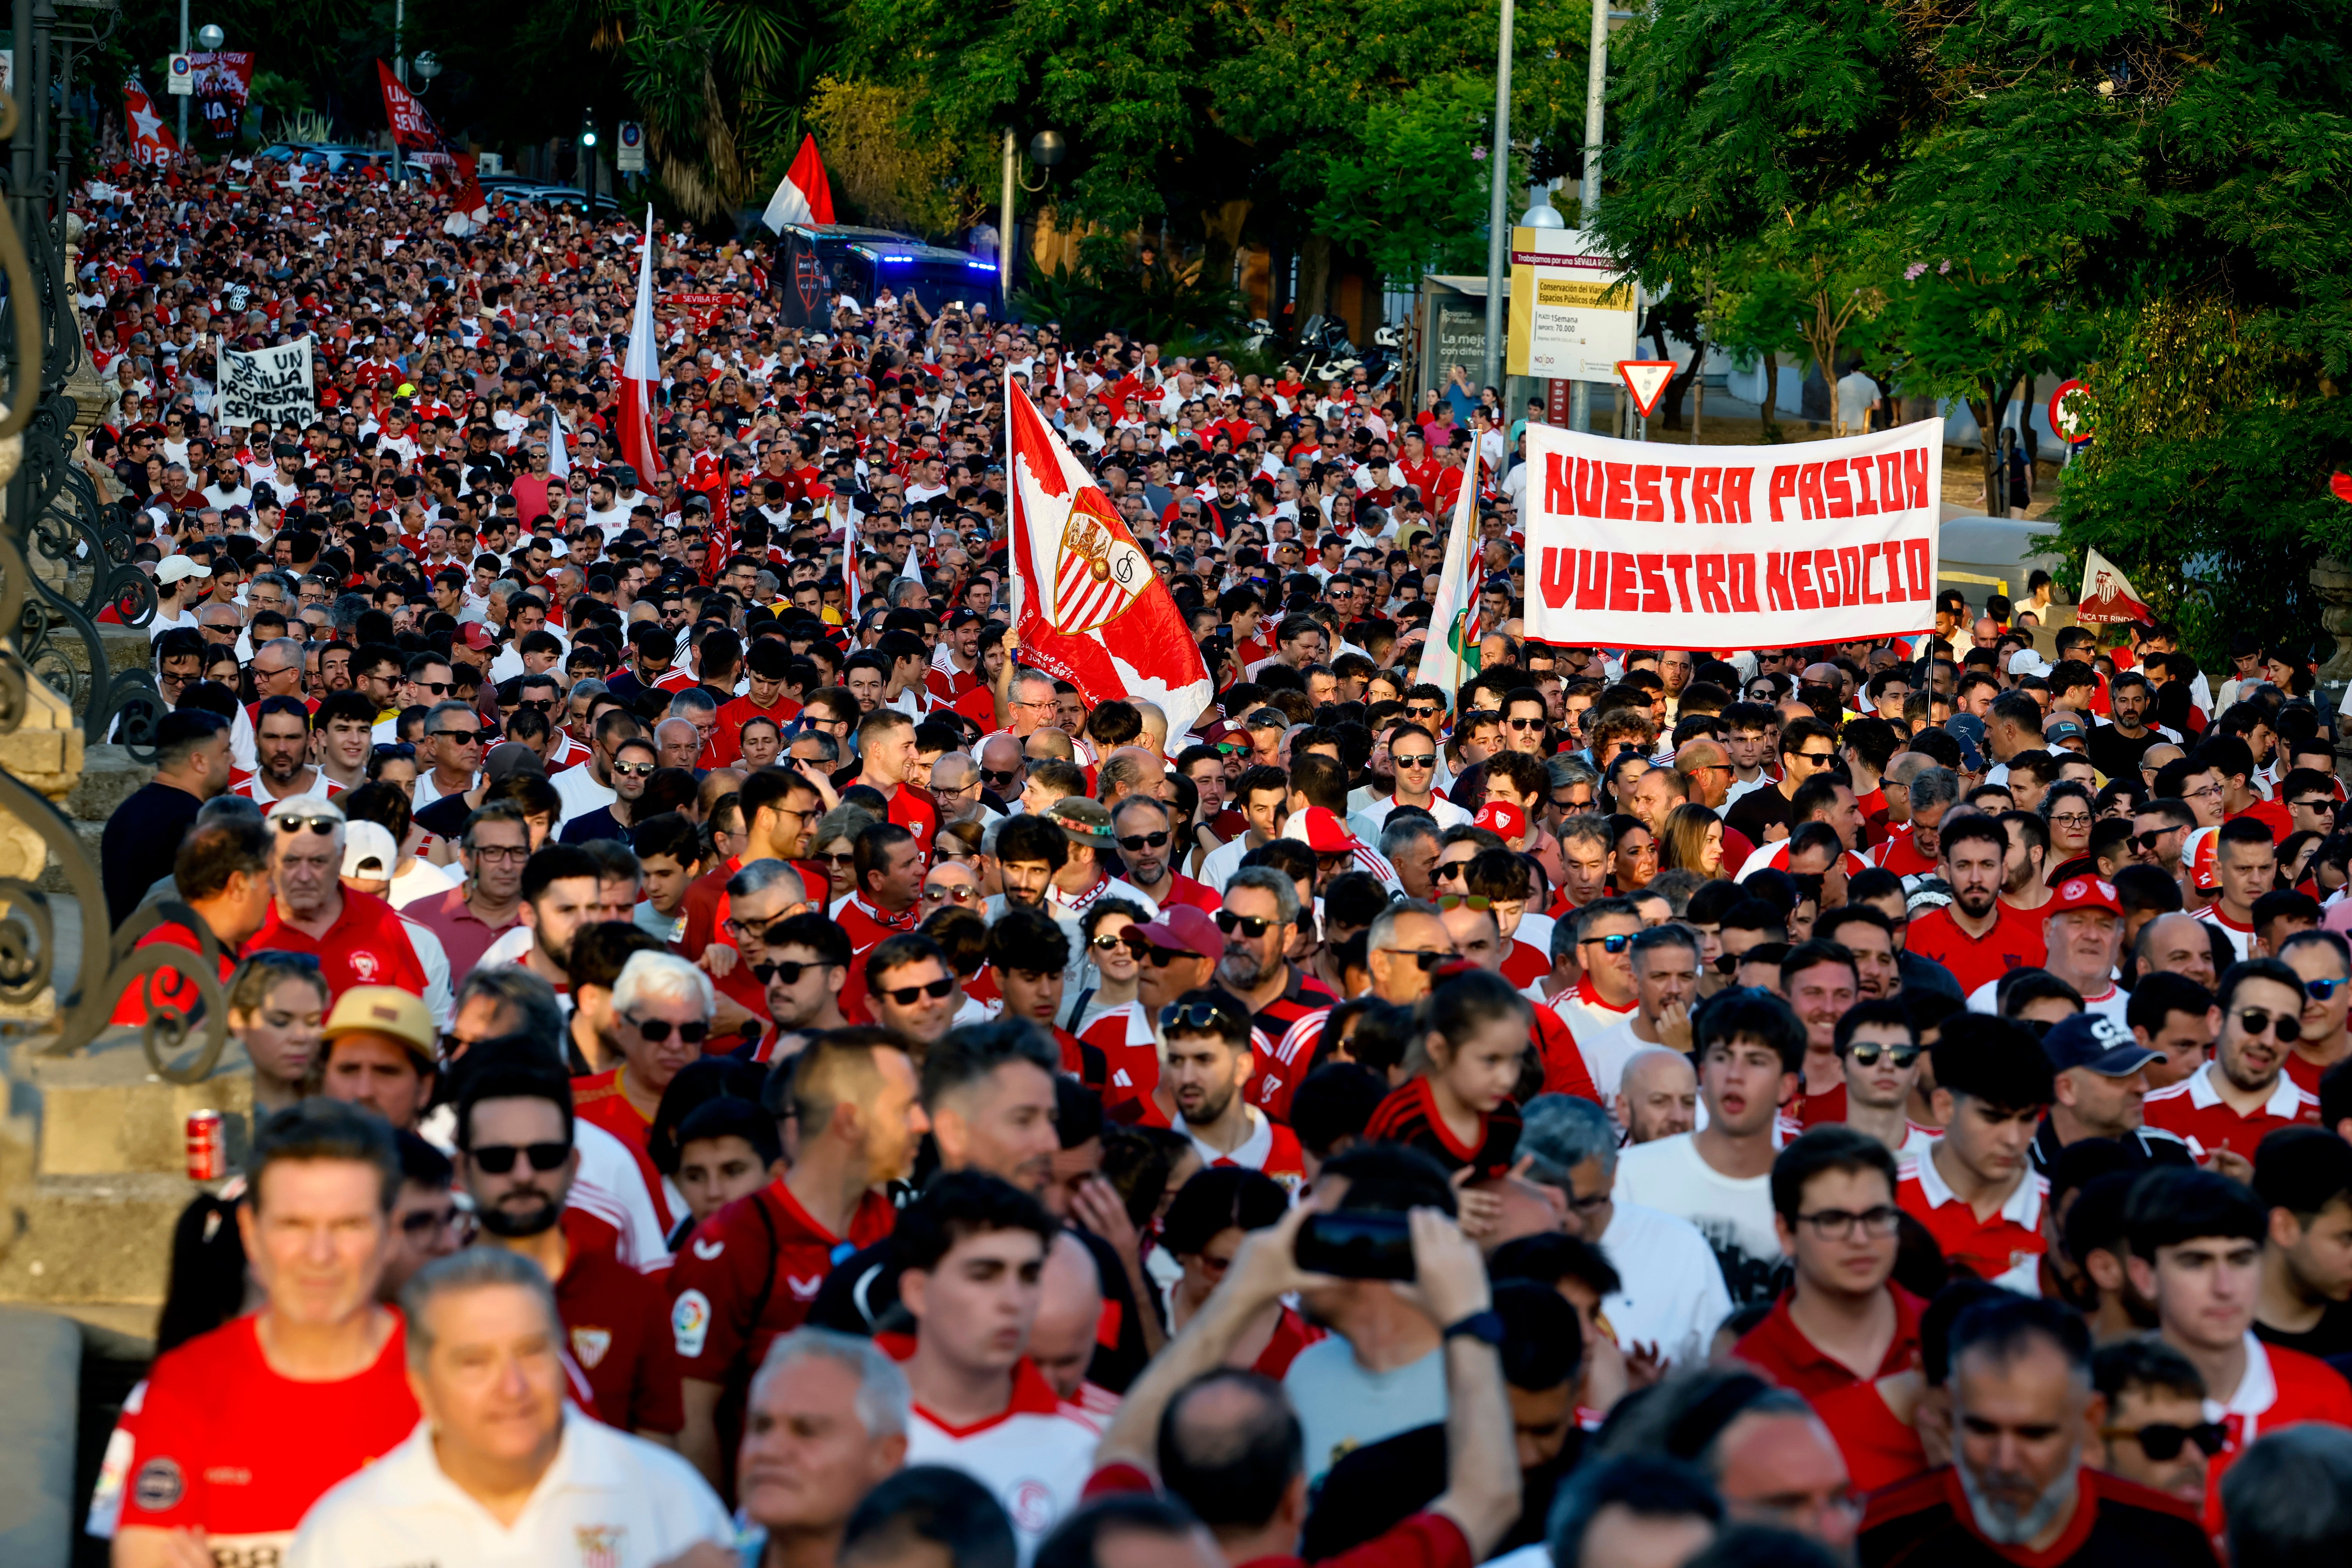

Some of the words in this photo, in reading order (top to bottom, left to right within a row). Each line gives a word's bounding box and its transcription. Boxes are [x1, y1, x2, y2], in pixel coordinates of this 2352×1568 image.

[1518, 254, 1551, 265] Trabajamos
[1551, 257, 1561, 265] por
[1540, 282, 1577, 292] Conservación
[1579, 283, 1588, 293] del
[682, 295, 710, 303] SEVILLA
[1539, 293, 1563, 303] Espacios
[1564, 294, 1588, 304] Públicos
[1555, 324, 1575, 332] 70.000
[1441, 333, 1456, 344] La
[273, 348, 304, 370] UN
[232, 368, 302, 390] SEVILLA
[221, 379, 314, 405] PROFESIONAL
[223, 399, 313, 424] SEVILLISTA
[1545, 452, 1755, 524] NUESTRA
[1769, 447, 1929, 522] PASION
[1539, 547, 1760, 613] VUESTRO
[1766, 538, 1931, 612] NEGOCIO
[2199, 872, 2212, 885] 14
